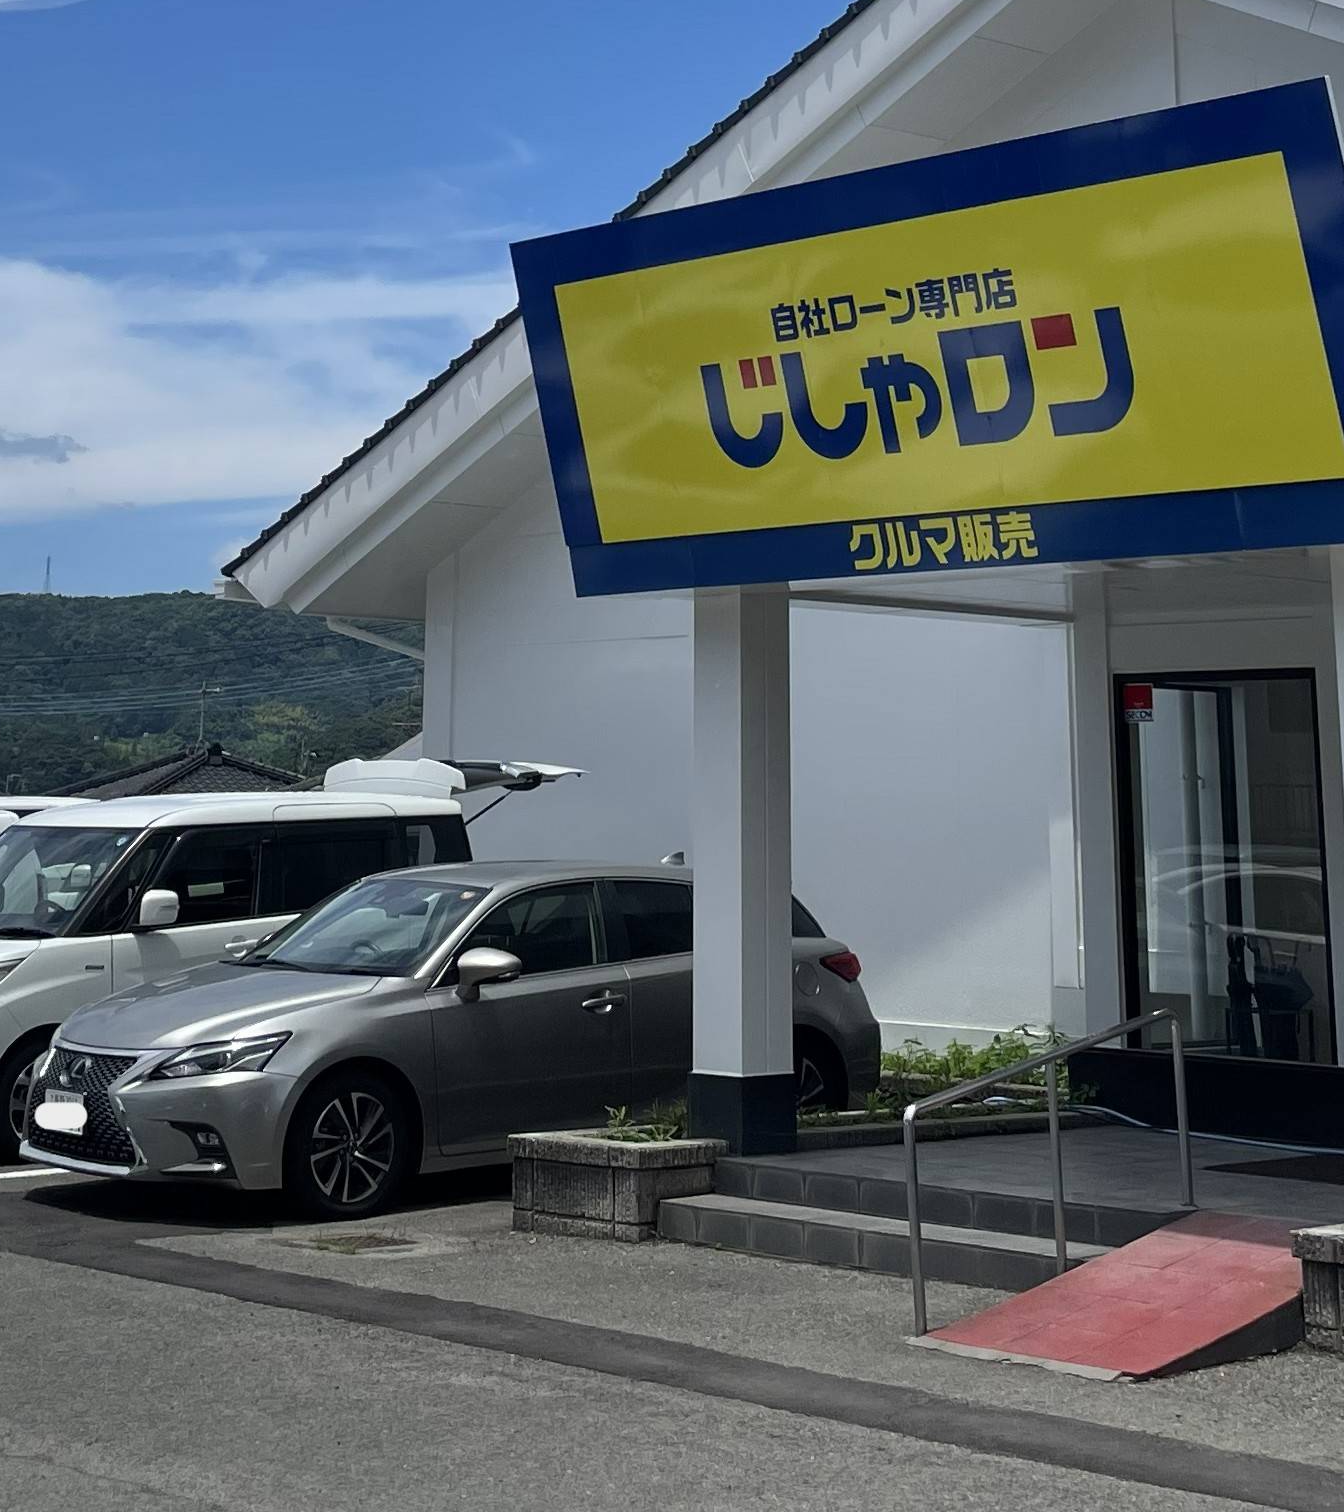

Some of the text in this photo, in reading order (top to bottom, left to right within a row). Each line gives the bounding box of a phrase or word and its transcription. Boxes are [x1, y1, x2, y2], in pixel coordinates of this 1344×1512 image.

[770, 268, 1017, 343] 自社ローン専門店
[700, 306, 1135, 469] じしゃロン
[849, 512, 1038, 570] クルマ販売
